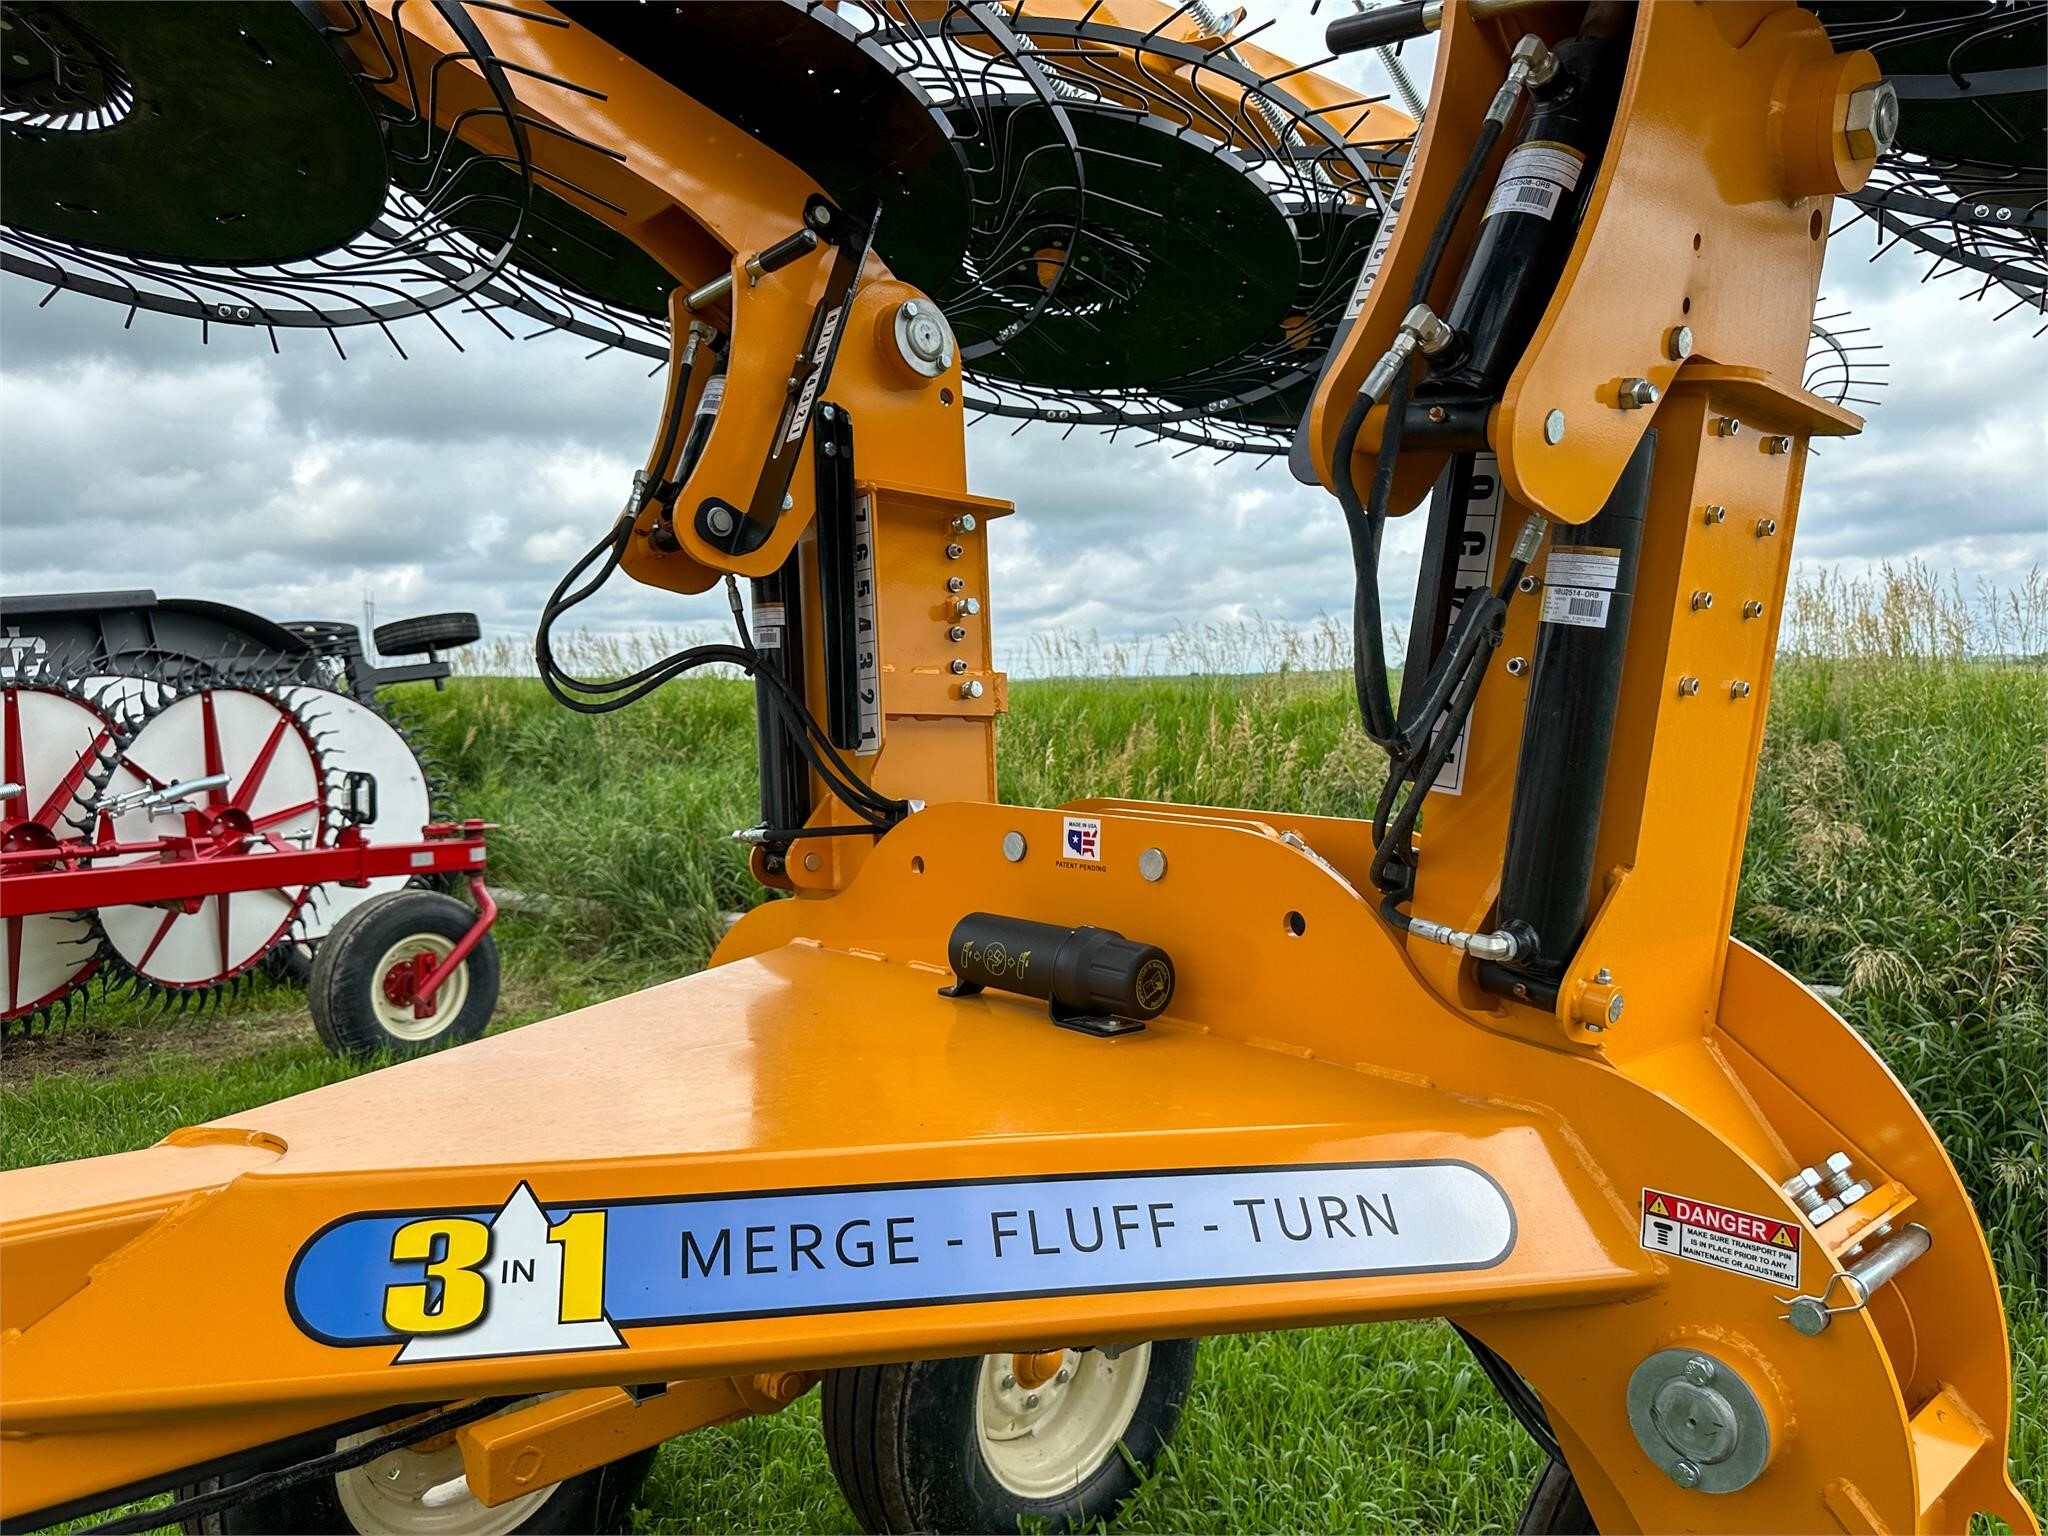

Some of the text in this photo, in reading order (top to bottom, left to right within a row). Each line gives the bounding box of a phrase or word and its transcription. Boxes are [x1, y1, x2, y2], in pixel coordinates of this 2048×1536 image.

[798, 409, 806, 418] 2
[860, 652, 873, 669] 3
[861, 688, 875, 704] 2
[862, 727, 876, 739] 1
[1056, 861, 1107, 872] PATENT PENDING
[1676, 1202, 1767, 1241] DANGER
[680, 1216, 920, 1280] MERGE
[991, 1202, 1175, 1258] FLUFF
[1233, 1193, 1401, 1243] TURN
[1687, 1227, 1792, 1261] MAKE SURE TRANSPORT PIN
[1682, 1246, 1795, 1282] MAINTENACE OR ADJUSTMENT
[1699, 1241, 1707, 1249] IN
[1708, 1243, 1733, 1256] PLACE
[1734, 1249, 1758, 1262] PRIOR
[1759, 1256, 1770, 1265] TO
[1770, 1259, 1788, 1270] ANY
[383, 1208, 608, 1337] 3 IN 1
